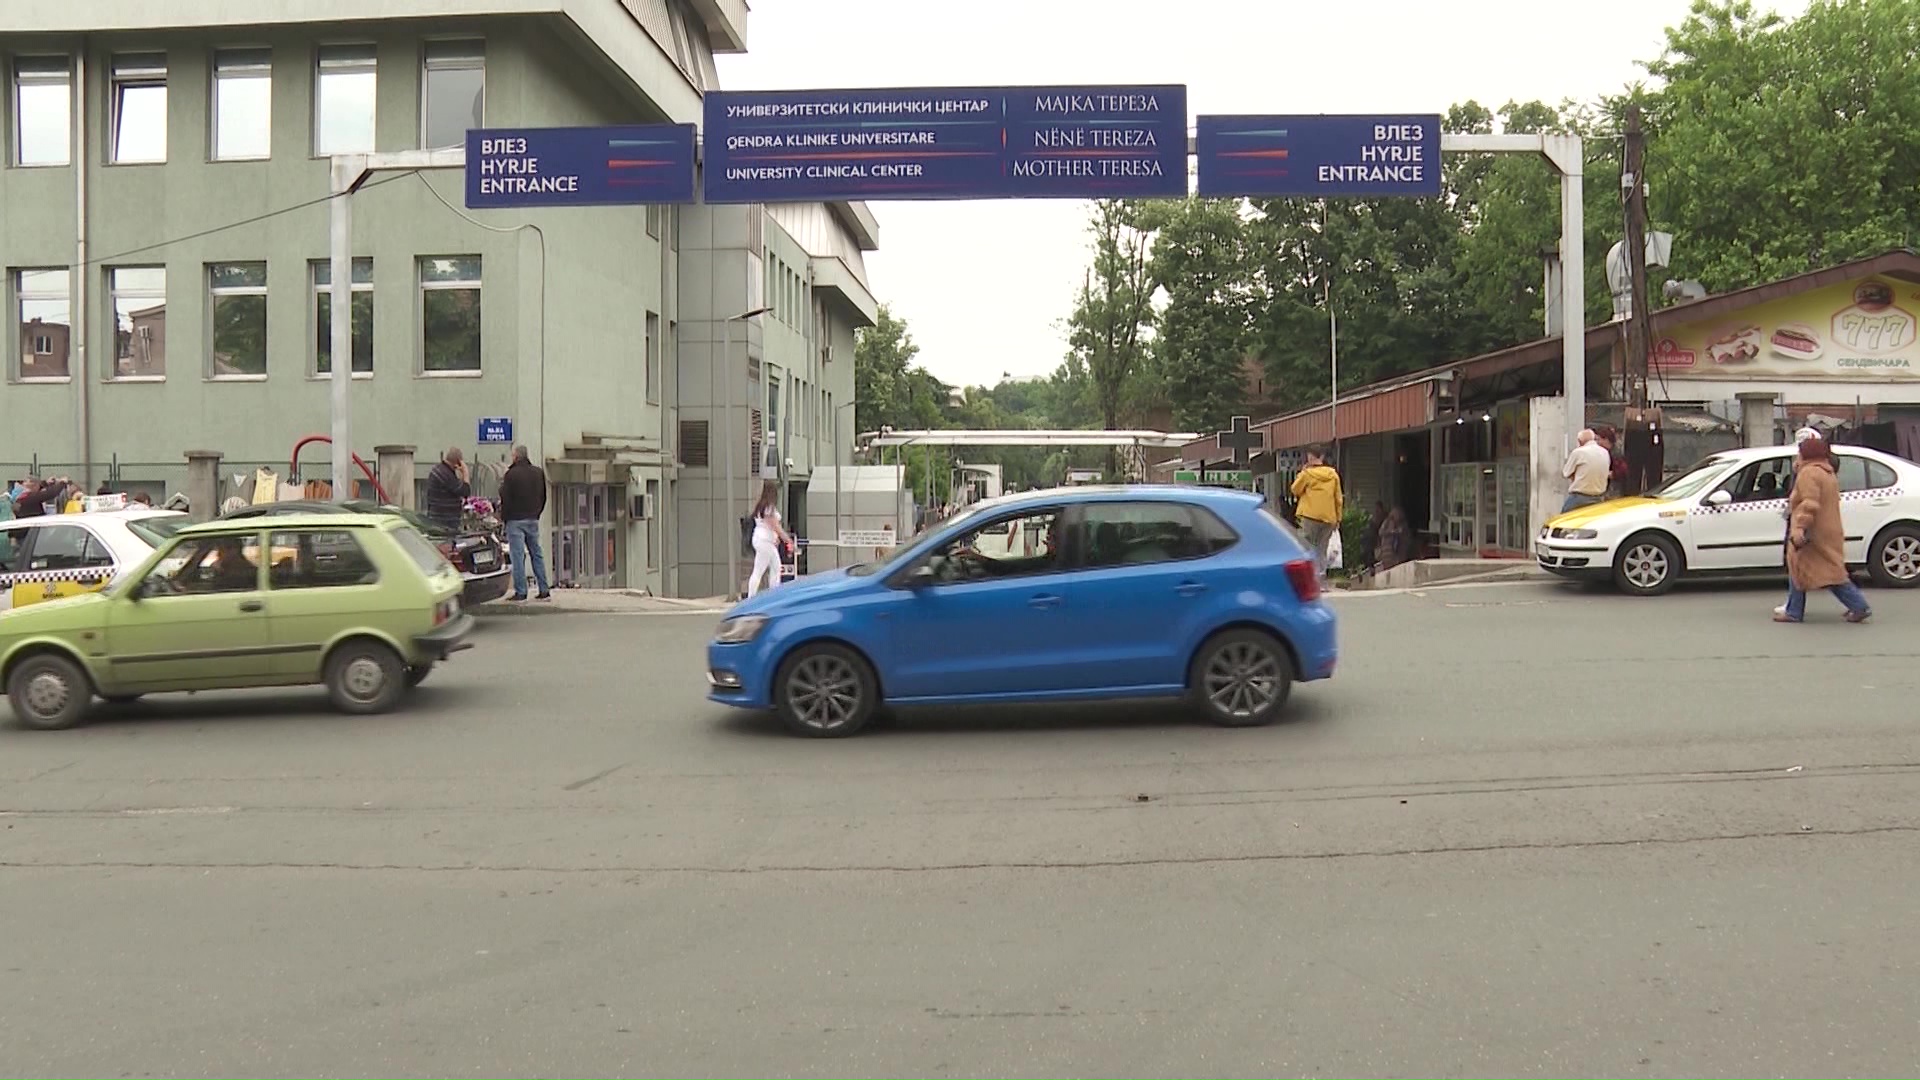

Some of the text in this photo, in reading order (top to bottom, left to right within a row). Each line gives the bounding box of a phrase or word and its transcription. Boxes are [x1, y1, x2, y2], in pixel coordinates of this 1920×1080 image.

[727, 100, 989, 118] УНИВЕРЗИТЕТСКИ КЛИНИЧКИ ЦЕНТАР
[1035, 94, 1159, 115] МАЈКА ТЕРЕЗА
[726, 132, 935, 150] QENDRA KLINIKE UNIVERSITARE
[1034, 127, 1157, 147] NËNË TEREZA
[1374, 124, 1424, 141] ВЛЕЗ
[481, 138, 527, 155] ВЛЕЗ
[1361, 145, 1423, 162] HYRJE
[481, 157, 538, 175] HYRJE
[726, 164, 923, 180] UNIVERSITY CLINICAL CENTER
[1013, 160, 1163, 177] MOTHER TERESA
[1318, 165, 1424, 182] ENTRANCE
[480, 176, 578, 194] ENTRANCE
[1842, 313, 1908, 350] 777
